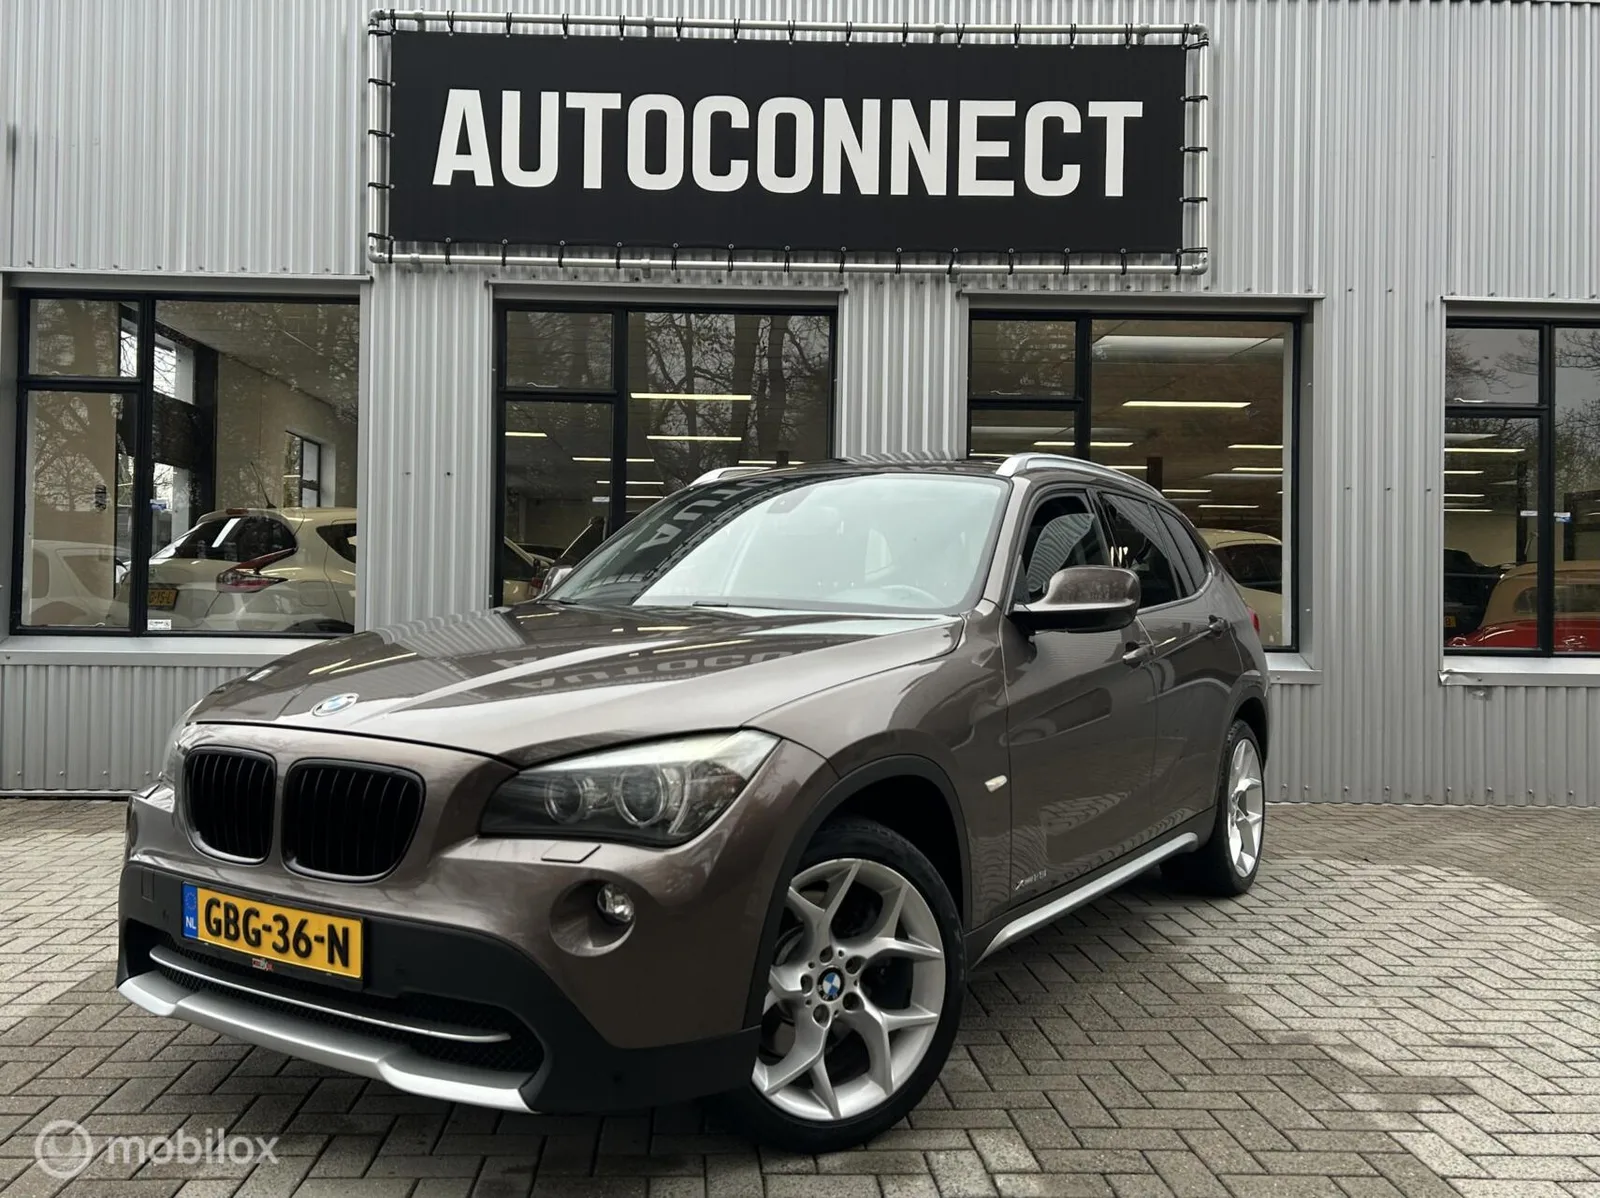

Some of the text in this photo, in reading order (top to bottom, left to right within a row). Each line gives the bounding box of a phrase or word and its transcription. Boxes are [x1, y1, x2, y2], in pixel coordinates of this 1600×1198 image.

[432, 88, 1143, 197] AUTOCONNECT
[185, 915, 197, 930] NL
[204, 897, 350, 968] GBG-36-N
